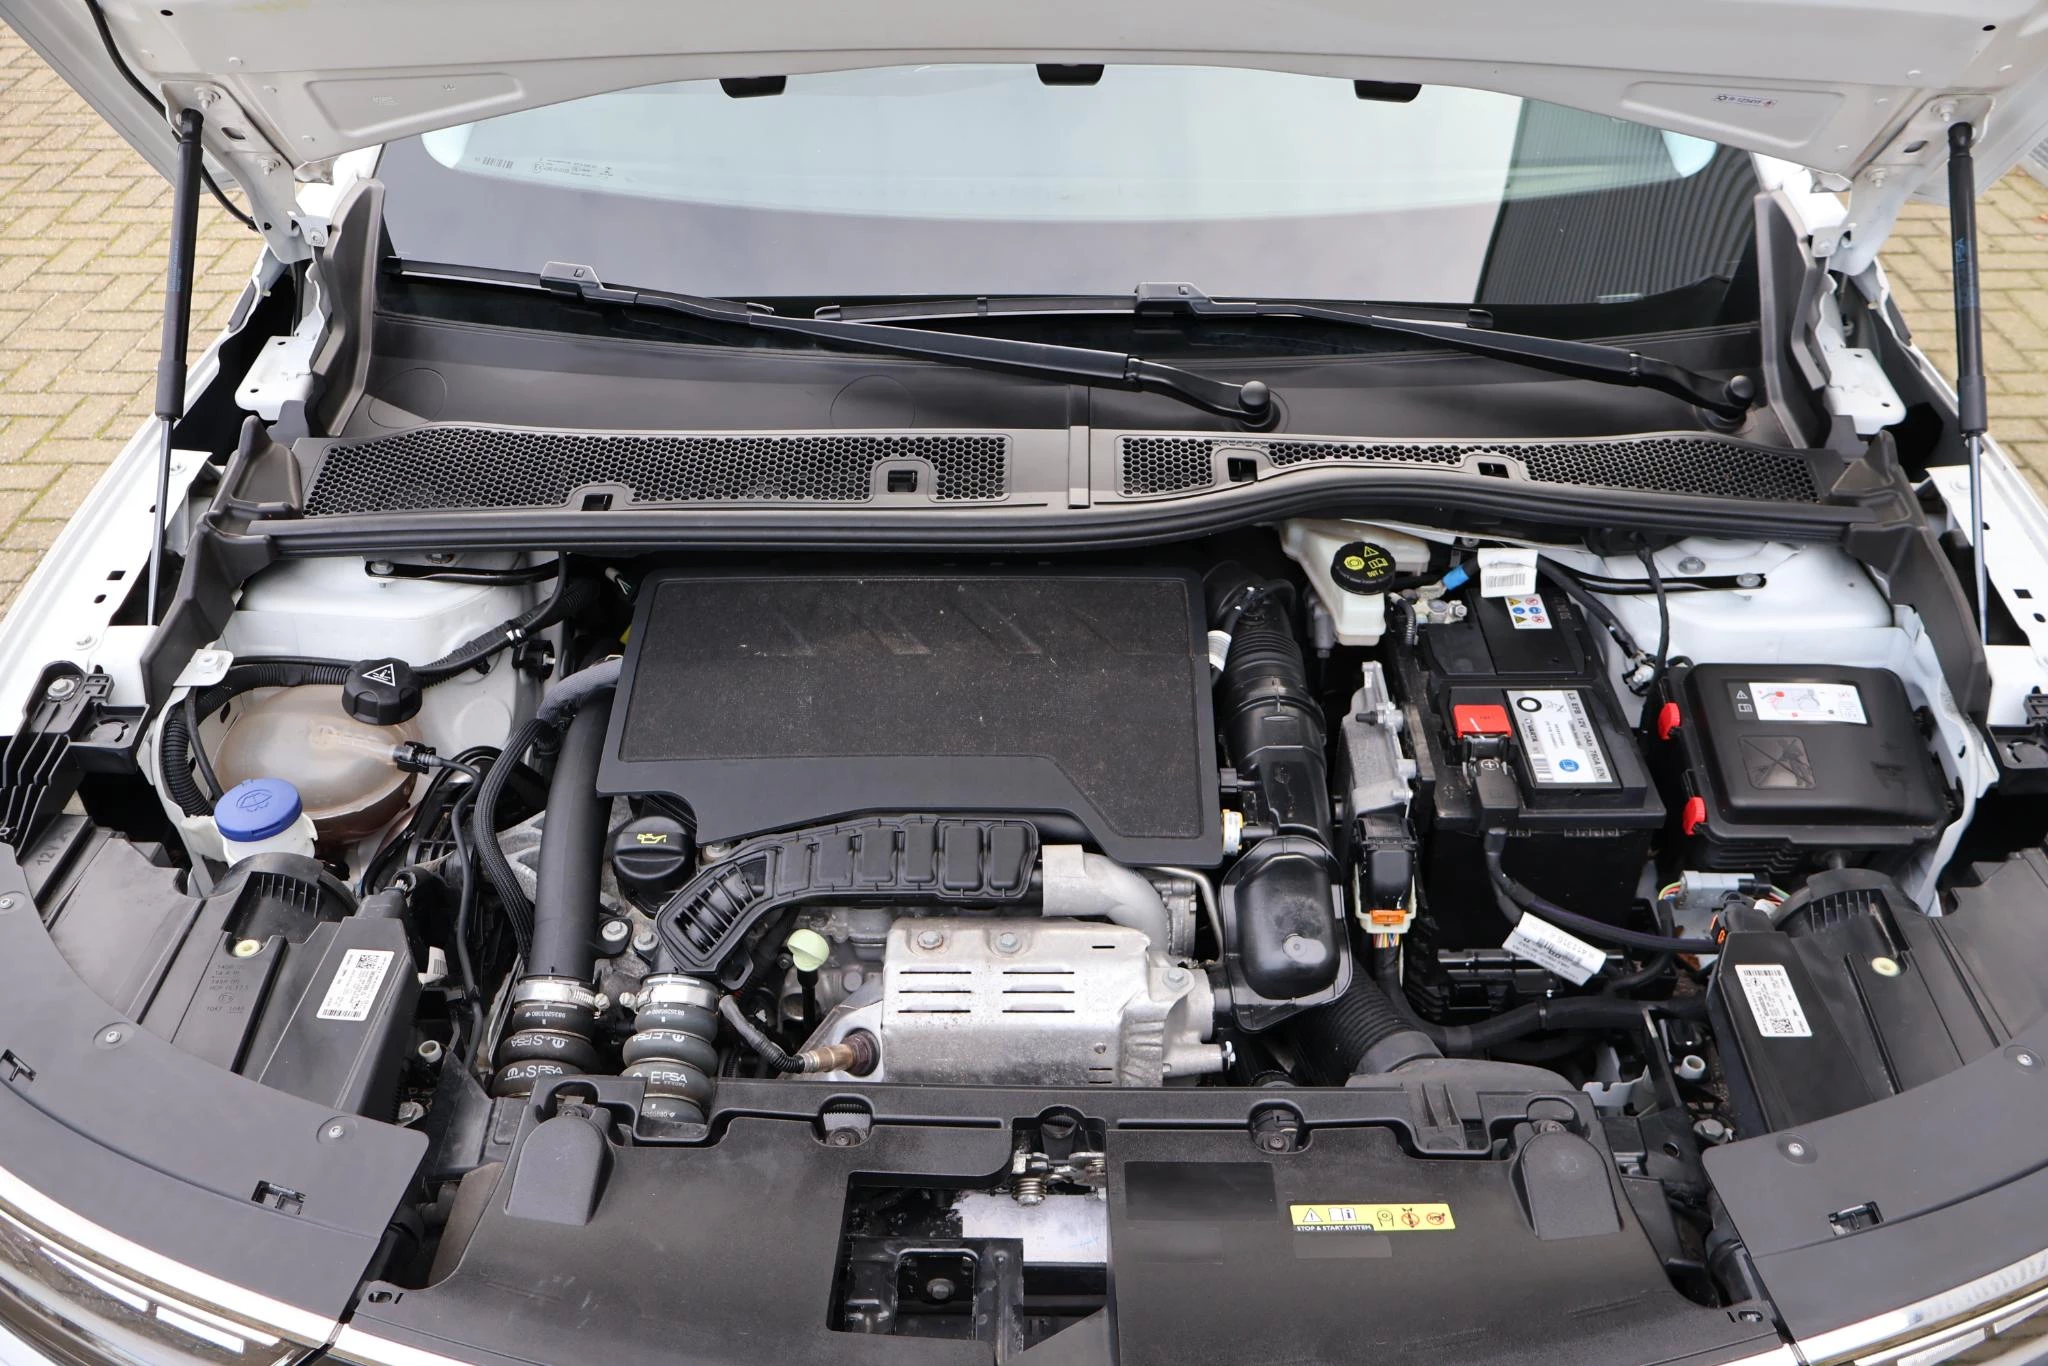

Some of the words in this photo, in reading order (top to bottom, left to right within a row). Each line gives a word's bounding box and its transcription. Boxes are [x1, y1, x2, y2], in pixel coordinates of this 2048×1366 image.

[1571, 703, 1582, 715] EFB
[1577, 717, 1587, 728] 12V
[1583, 731, 1593, 747] 70Ah
[511, 1036, 533, 1047] PSA
[632, 1033, 651, 1042] PSA
[525, 1065, 537, 1078] S
[538, 1065, 563, 1075] PSA
[650, 1071, 662, 1085] E
[662, 1071, 688, 1084] PSA
